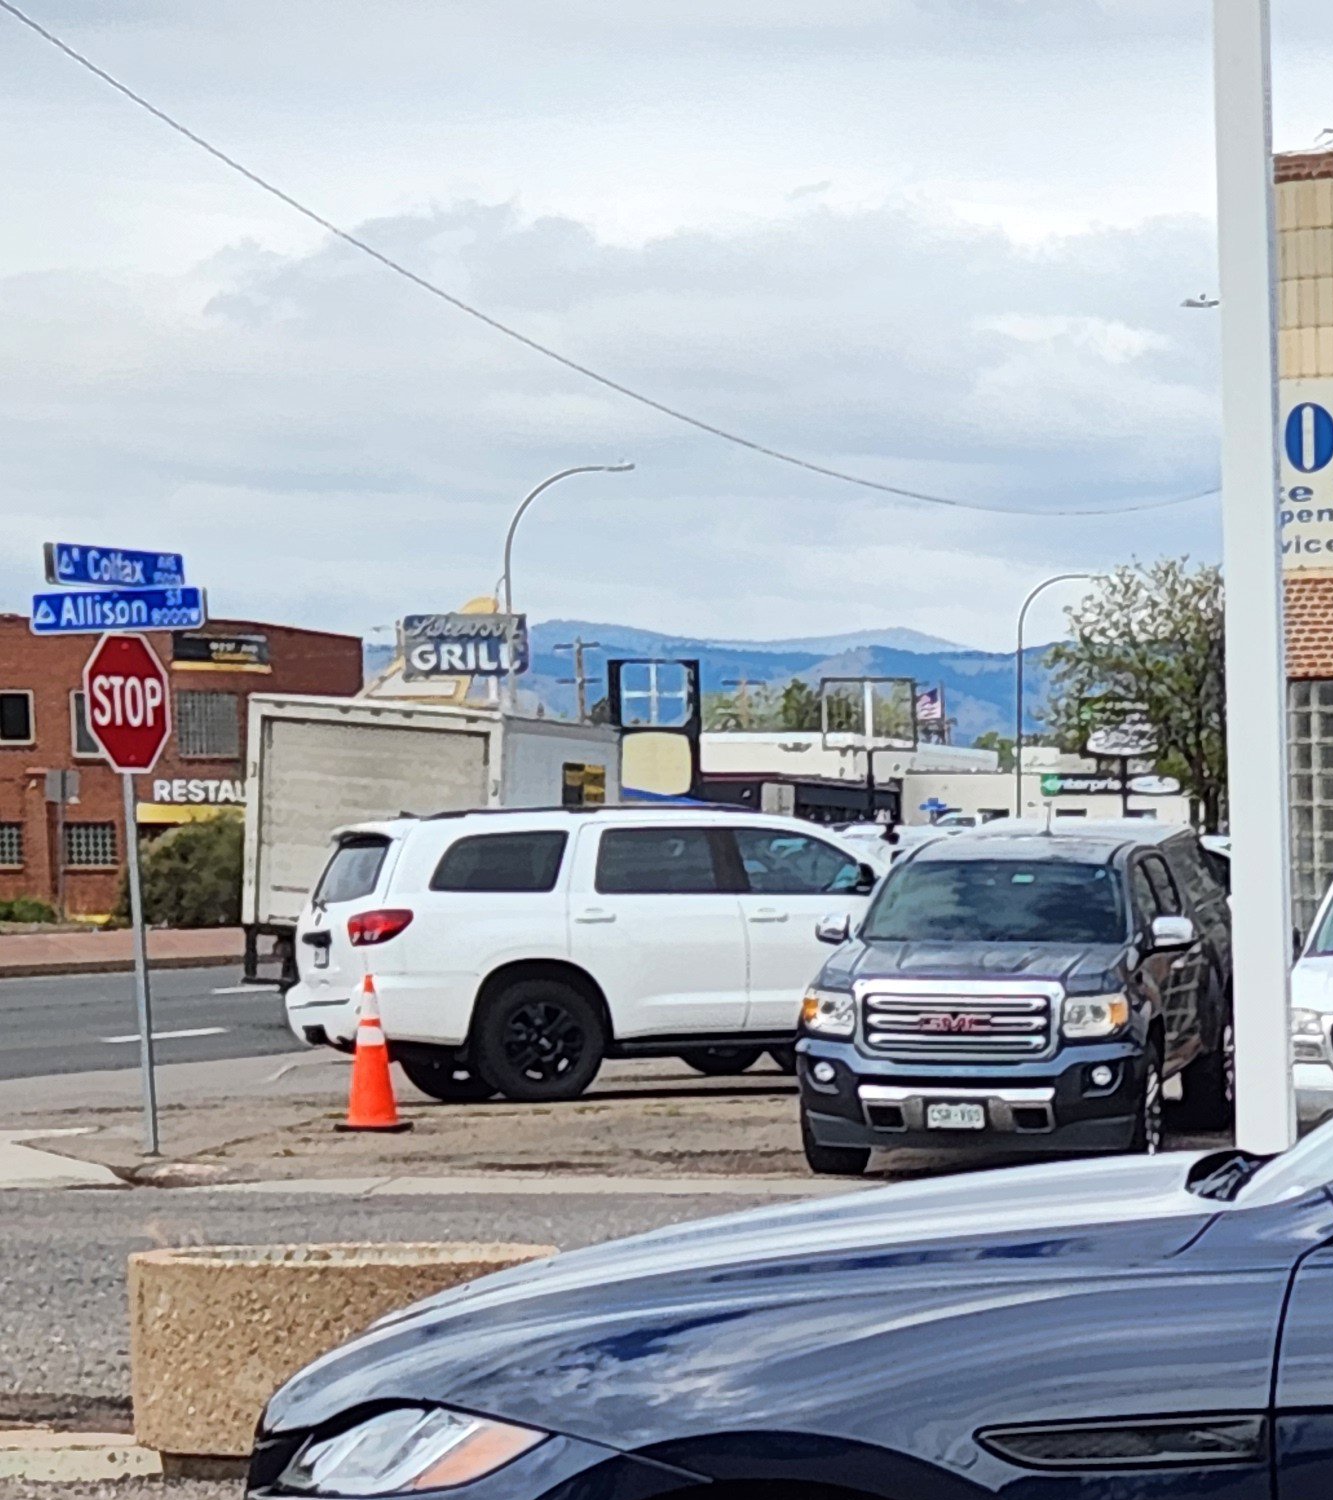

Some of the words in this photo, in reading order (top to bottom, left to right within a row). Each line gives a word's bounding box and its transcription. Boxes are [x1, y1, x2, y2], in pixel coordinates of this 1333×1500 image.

[87, 550, 145, 584] Colfax
[60, 595, 148, 626] Allison
[410, 641, 521, 671] GRILL
[92, 675, 162, 727] STOP
